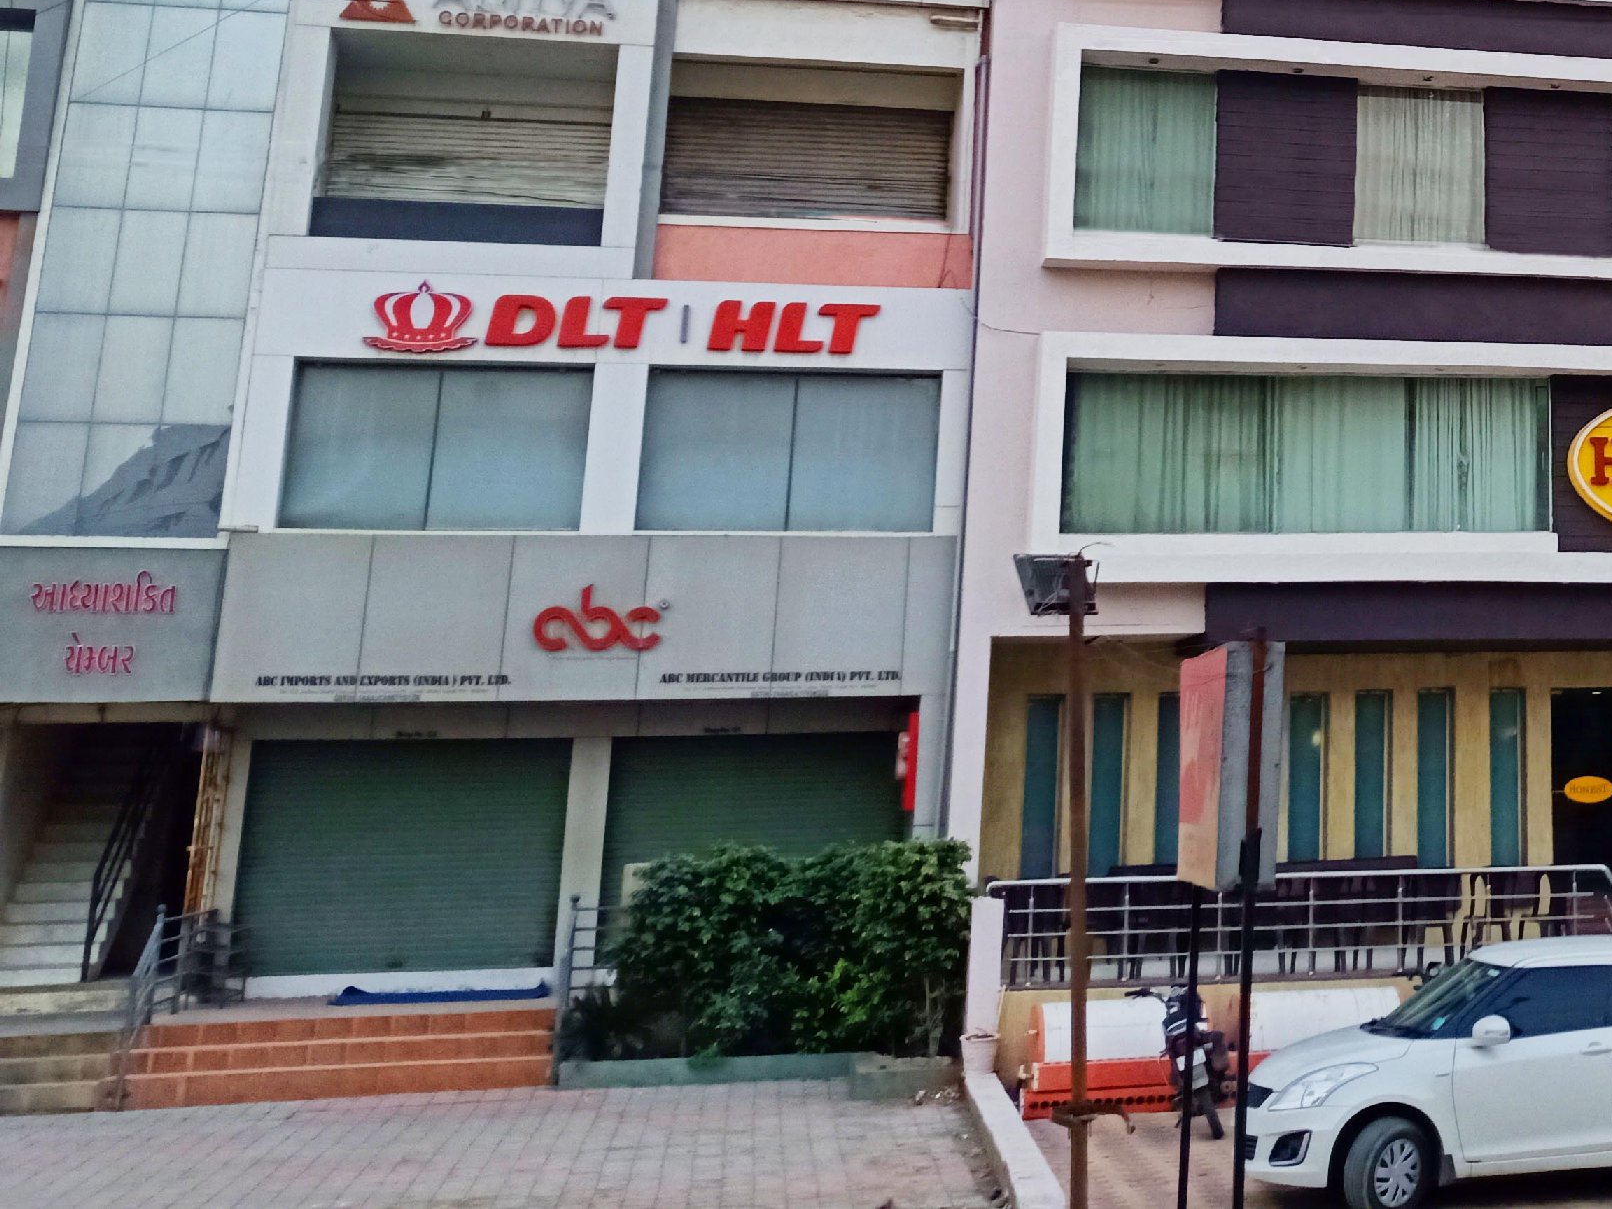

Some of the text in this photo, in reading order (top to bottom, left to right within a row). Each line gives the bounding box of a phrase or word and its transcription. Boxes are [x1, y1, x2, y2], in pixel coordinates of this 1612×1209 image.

[438, 10, 603, 36] CORPORATION
[485, 295, 668, 348] DLT
[707, 299, 881, 354] HLT
[533, 584, 661, 652] abc
[255, 676, 278, 686] ABC
[280, 675, 332, 686] IMPORTS
[334, 675, 357, 686] AND
[359, 675, 410, 686] EXPORTS
[660, 673, 683, 683] ABC
[686, 672, 759, 683] MERCANTILE
[762, 672, 802, 683] GROUP
